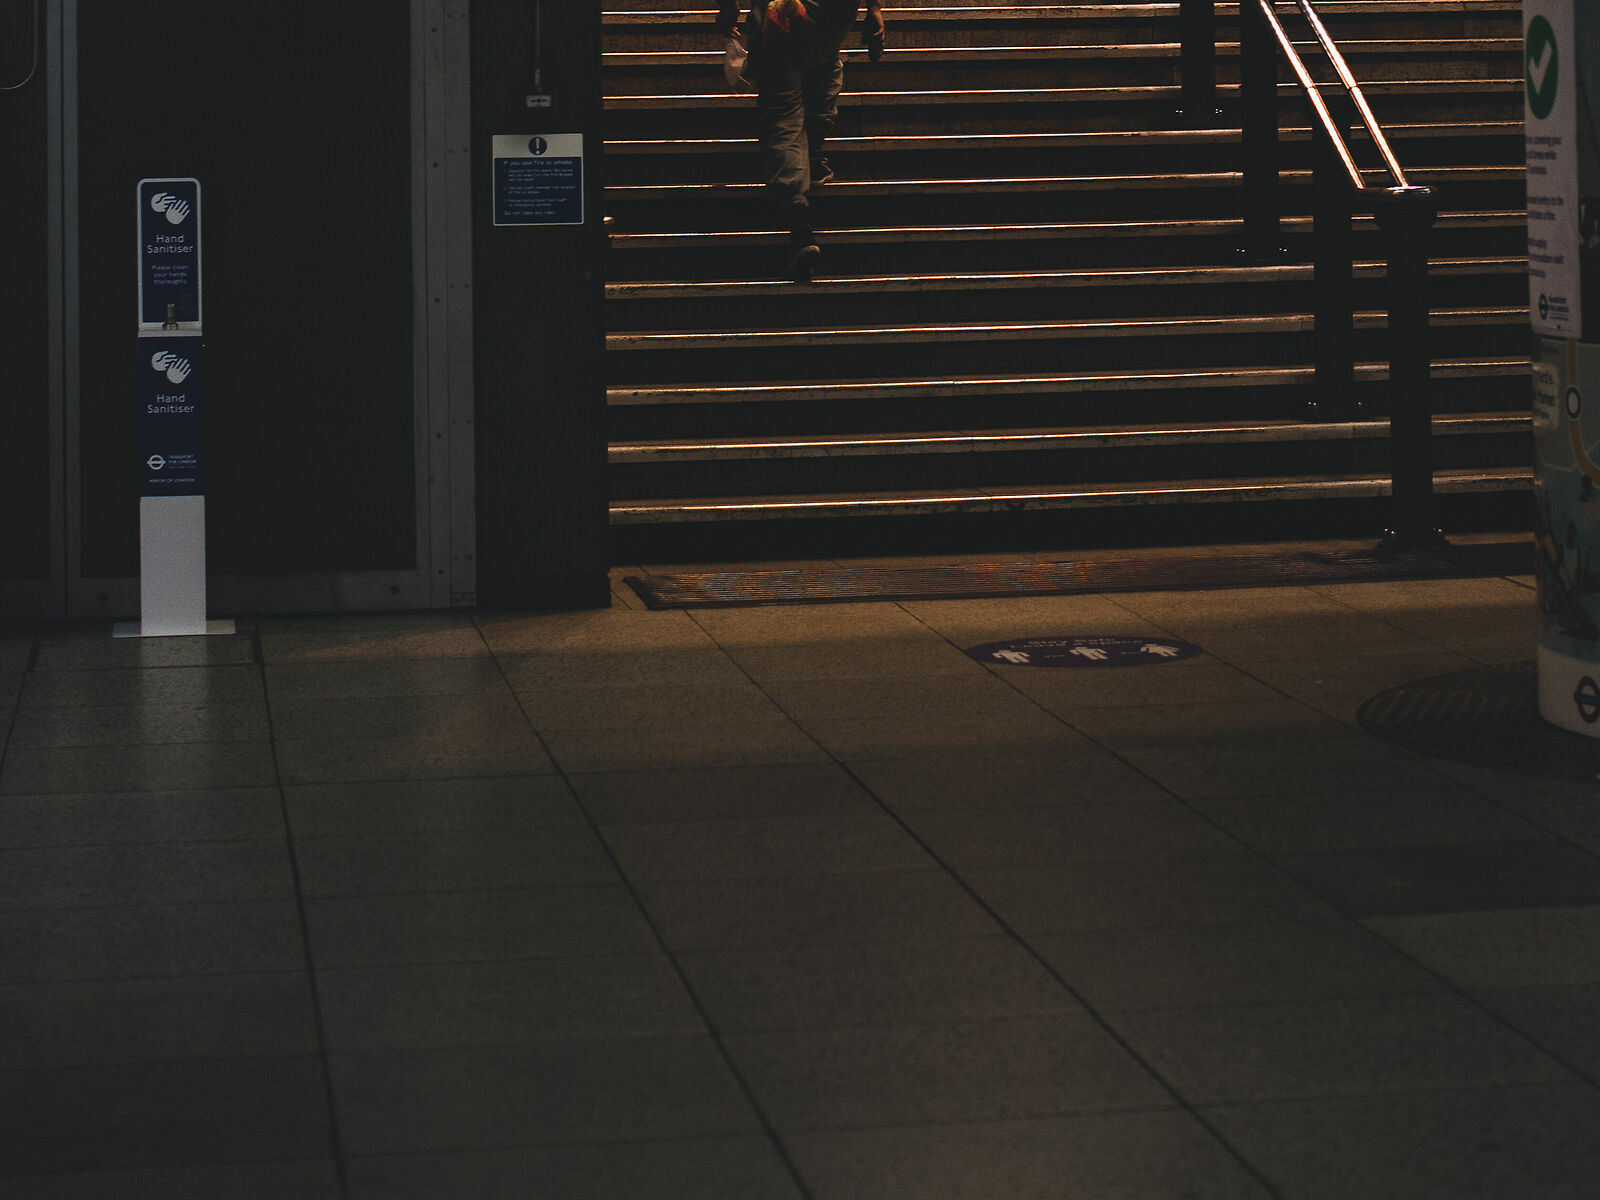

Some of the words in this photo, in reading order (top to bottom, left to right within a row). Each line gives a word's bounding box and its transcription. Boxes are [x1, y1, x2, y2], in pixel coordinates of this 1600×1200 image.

[156, 234, 184, 243] Hand
[147, 244, 194, 254] Sanitiser
[156, 394, 185, 403] Hand
[147, 404, 195, 414] Sanitiser
